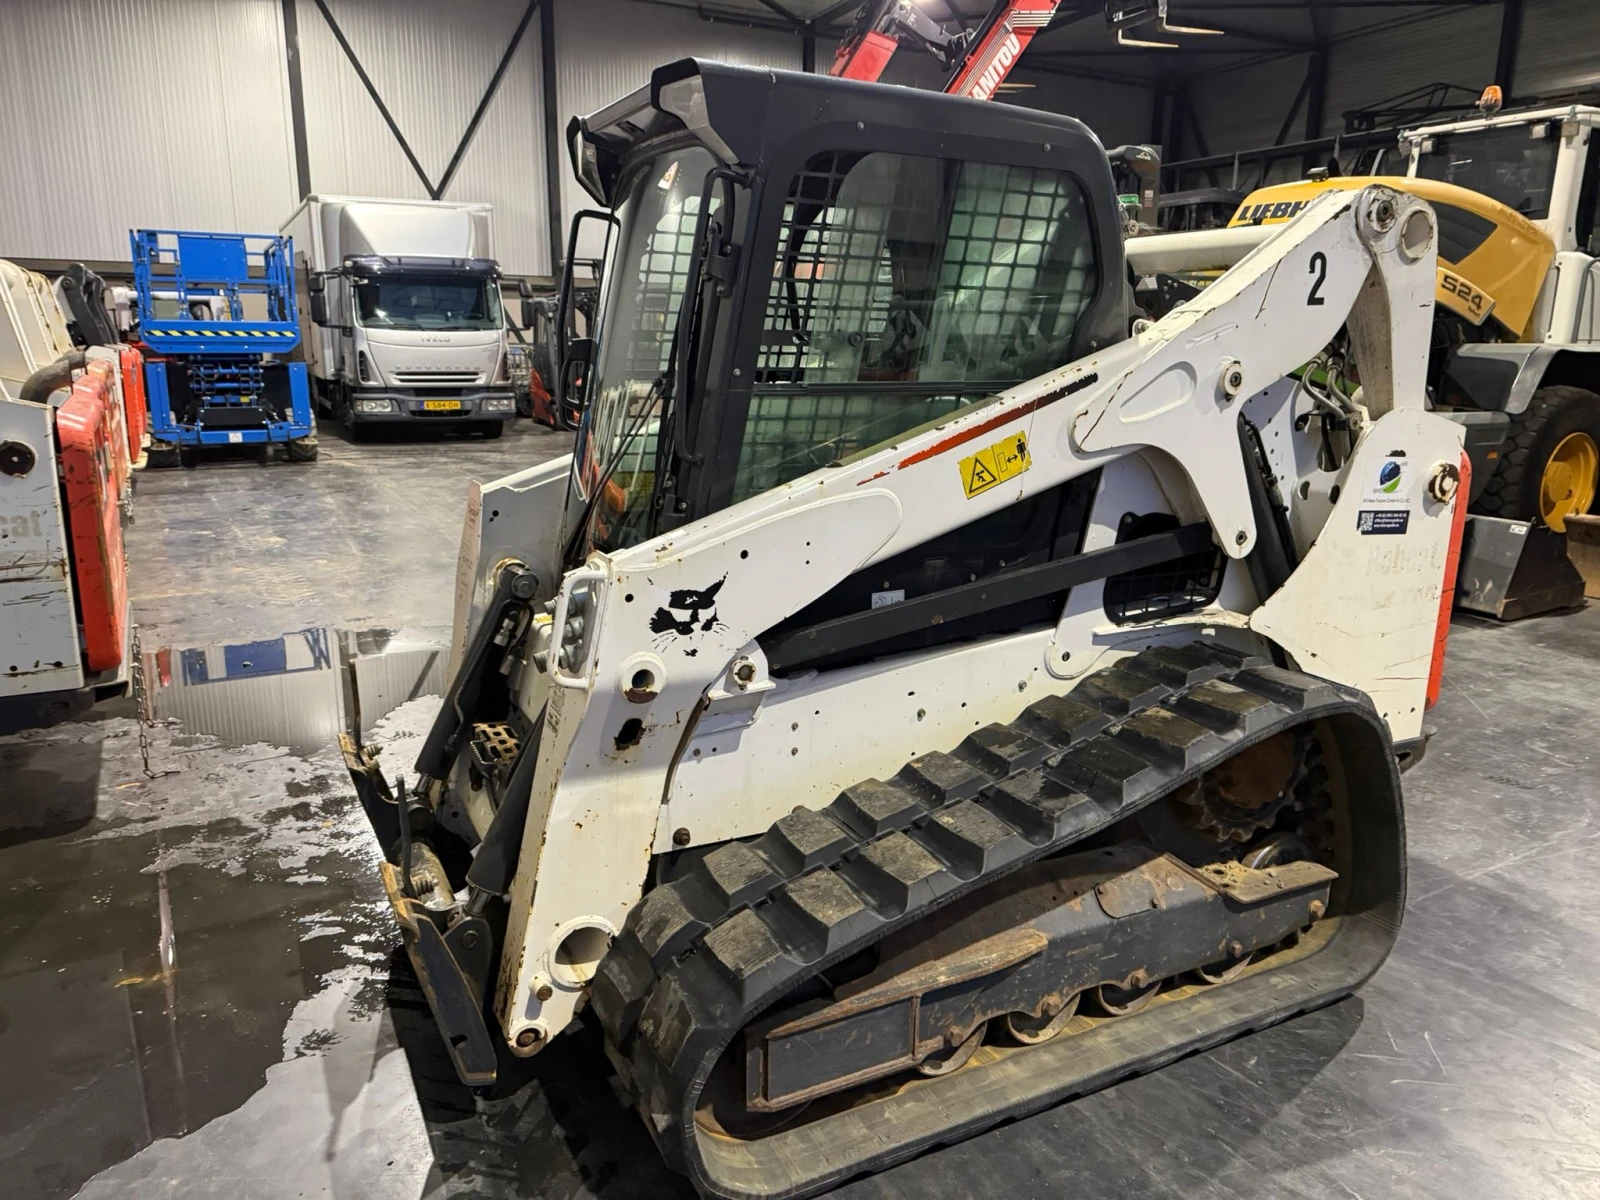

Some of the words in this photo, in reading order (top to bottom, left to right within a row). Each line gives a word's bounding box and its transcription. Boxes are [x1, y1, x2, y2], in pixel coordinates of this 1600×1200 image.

[968, 33, 1021, 100] ANITOU
[1307, 251, 1327, 306] 2
[1441, 273, 1483, 311] 524
[420, 335, 451, 343] IVECO
